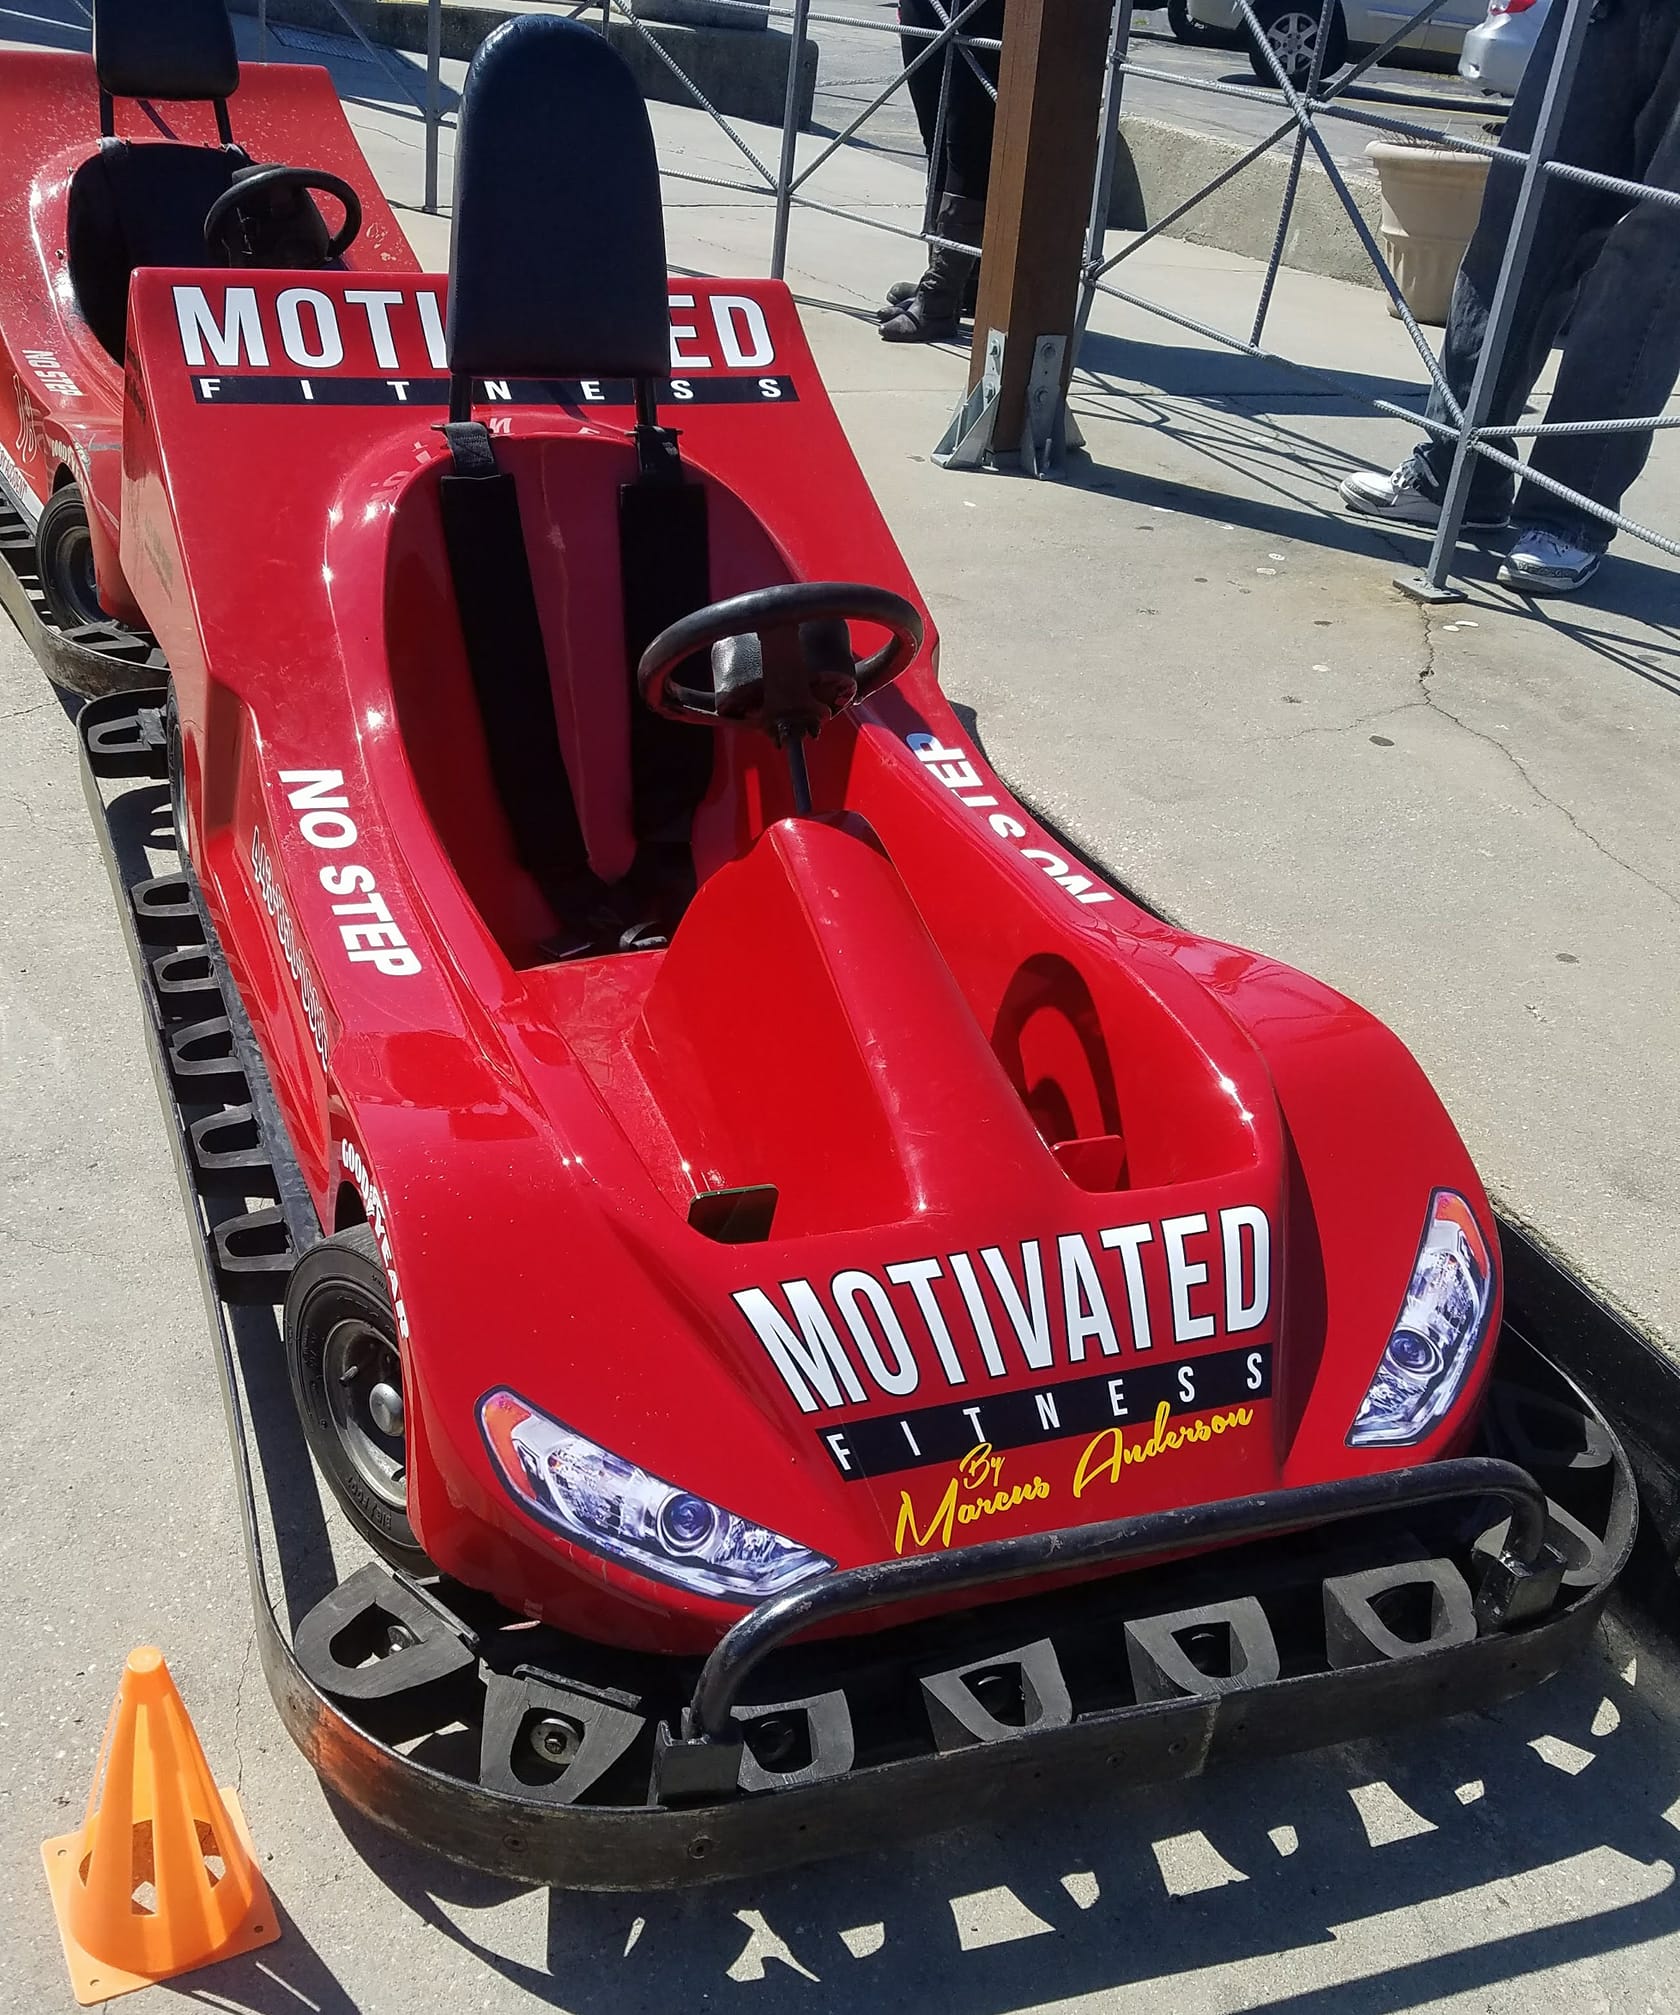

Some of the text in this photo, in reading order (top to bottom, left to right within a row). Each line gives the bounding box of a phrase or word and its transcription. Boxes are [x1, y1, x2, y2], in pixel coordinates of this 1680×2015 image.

[21, 349, 60, 369] NO
[172, 286, 775, 369] MOTIED
[34, 370, 87, 396] STEP
[199, 378, 782, 401] FITNESS
[278, 769, 423, 976] NO STEP
[732, 1205, 1271, 1413] MOTIVATED
[826, 1353, 1263, 1472] FITNESS
[894, 1401, 1254, 1556] Marcus Anderson
[959, 1442, 1006, 1490] By
